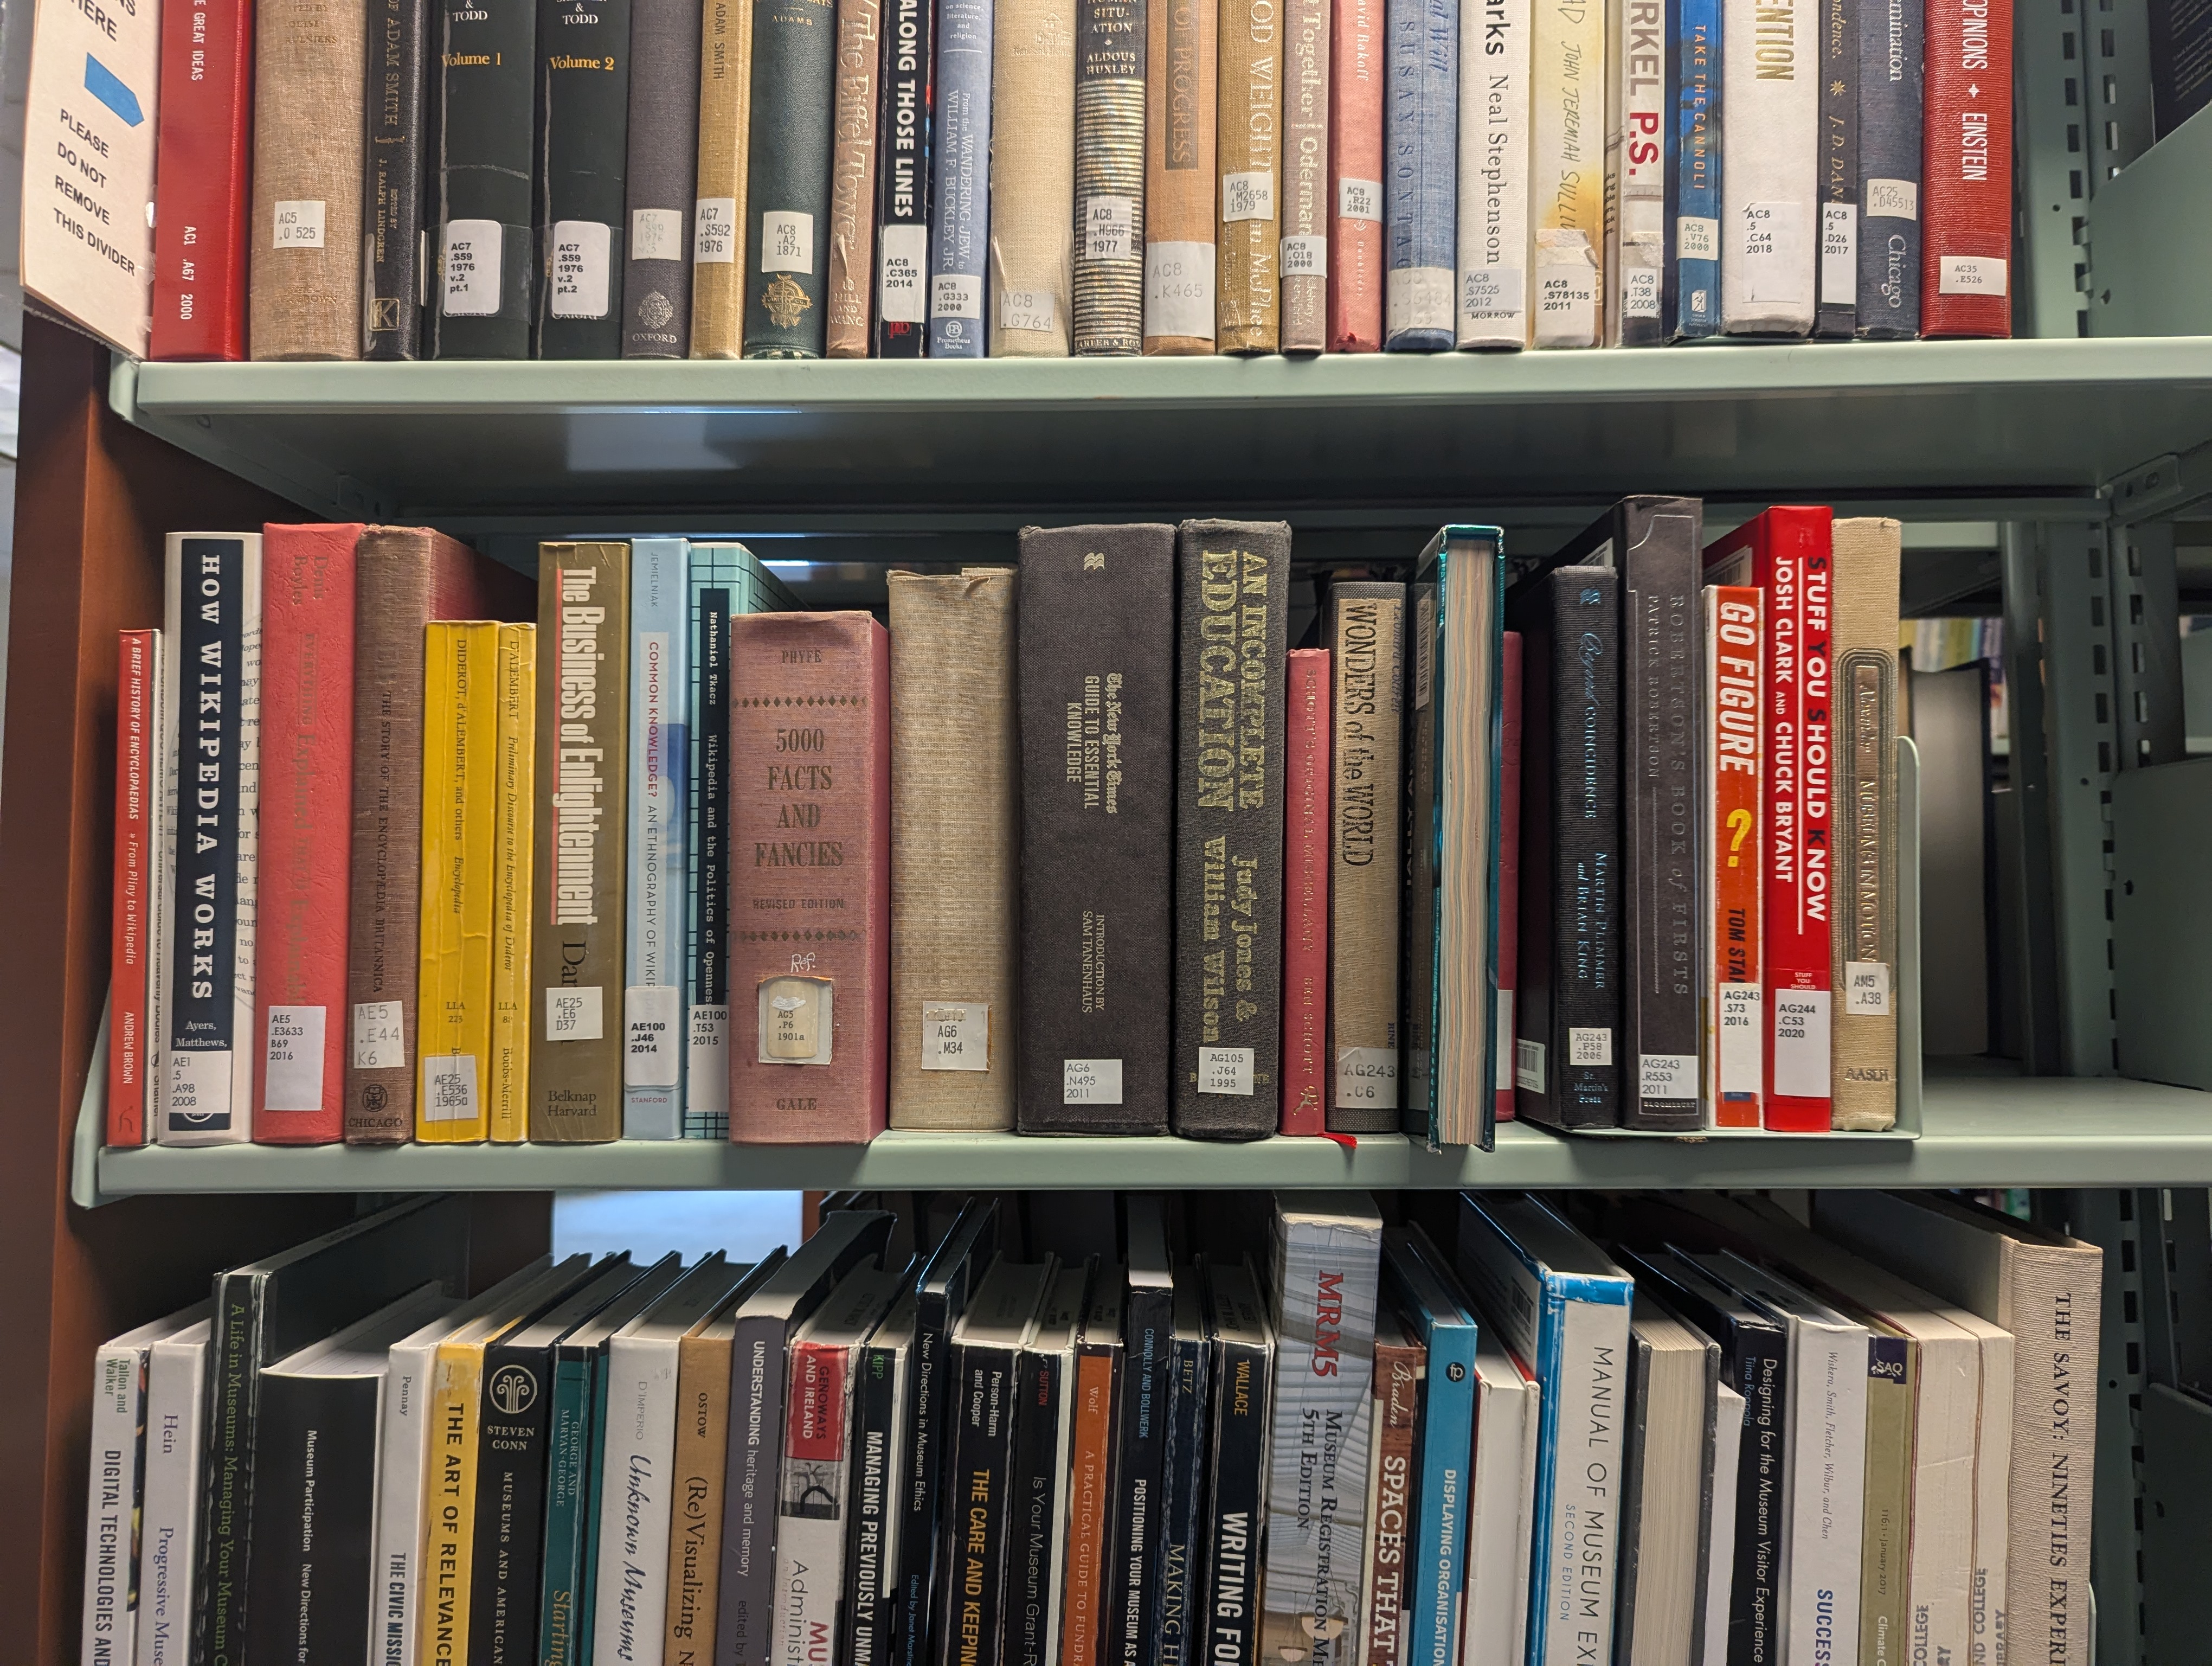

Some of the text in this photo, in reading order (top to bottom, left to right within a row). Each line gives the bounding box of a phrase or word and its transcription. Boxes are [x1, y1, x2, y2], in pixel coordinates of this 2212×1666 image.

[453, 10, 487, 22] TODD
[563, 14, 598, 24] TODD
[191, 12, 205, 81] GREAT IDEAS
[442, 53, 501, 66] Volume 1
[550, 56, 614, 69] Volume 2
[384, 18, 399, 126] ADAM SMITH
[895, 0, 918, 217] ALONG THOSE LINES
[1693, 25, 1706, 190] TAKE THE CANNOLI
[60, 109, 109, 158] PLEASE
[1629, 112, 1658, 176] P.S.
[1962, 112, 1987, 181] EINSTEIN
[58, 142, 107, 189] DO NOT
[1481, 75, 1509, 265] Neal Stephenson
[55, 175, 110, 226] REMOVE
[1746, 210, 1770, 219] AC8
[53, 208, 135, 276] THIS DIVIDER
[451, 242, 472, 251] AC7
[1746, 234, 1771, 242] .C64
[1746, 245, 1772, 254] 2018
[180, 226, 196, 320] AC1 .A67 2000
[450, 284, 468, 293] pt.1
[451, 263, 475, 271] 1976
[1545, 279, 1568, 289] AC8
[1881, 235, 1907, 308] Chicago
[1544, 291, 1589, 300] .S78135
[1544, 302, 1571, 310] 2011
[131, 648, 141, 675] BRIEF
[1198, 549, 1238, 811] EDUCATION
[1239, 552, 1268, 809] AN INCOMPLETE
[128, 677, 141, 720] HISTORY
[706, 612, 718, 799] Nathaniel Tkacz Wikipedia
[1719, 601, 1756, 776] GO FIGURE
[130, 723, 140, 736] OF
[647, 642, 659, 797] COMMON KNOWLEDGE?
[776, 729, 824, 752] 5000
[1066, 702, 1082, 782] KNOWLEDGE
[1084, 675, 1100, 809] GUIDE TO ESSENTIAL
[1774, 558, 1793, 882] JOSH CLARK AND CHUCK BRYANT
[1806, 557, 1827, 921] STUFF YOU SHOULD KNOW
[552, 566, 605, 925] The Business of Enlightenment
[127, 736, 140, 821] ENCYCLOPAEDIAS
[191, 555, 222, 998] HOW WIKIPEDIA WORKS
[768, 765, 832, 790] FACTS
[777, 804, 820, 828] AND
[754, 842, 843, 867] FANCIES
[1203, 836, 1226, 1043] William Wilson
[1231, 855, 1258, 1021] Judy Jones &
[1724, 991, 1760, 1001] AG243
[1724, 1003, 1745, 1013] .S73
[185, 1020, 216, 1031] Ayers,
[271, 1027, 303, 1036] .E3633
[272, 1015, 290, 1023] AE5
[631, 1023, 665, 1031] AE100
[631, 1033, 654, 1043] .J46
[1724, 1017, 1748, 1026] 2016
[123, 1013, 134, 1084] ANDREW BROWN
[176, 1037, 227, 1048] Matthews,
[271, 1040, 288, 1048] B69
[271, 1051, 293, 1060] 2016
[631, 1045, 657, 1053] 2014
[1210, 1054, 1243, 1063] AG105
[1066, 1063, 1090, 1072] AG6
[1066, 1077, 1095, 1086] .N495
[1210, 1078, 1236, 1088] 1995
[1212, 1066, 1236, 1075] .J64
[548, 1090, 596, 1104] Belknap
[548, 1105, 596, 1117] Harvard
[1066, 1089, 1090, 1099] 2011
[349, 1118, 403, 1127] CHICAGO
[1312, 1271, 1343, 1377] MRM5
[803, 1355, 818, 1439] AND IRELAND
[815, 1367, 828, 1440] GENOWAYS
[1234, 1361, 1250, 1416] WALLACE
[163, 1413, 178, 1454] Hein
[488, 1426, 535, 1436] STEVEN
[492, 1439, 527, 1450] CONN
[2049, 1293, 2072, 1567] THE SAVOY: NINETIES
[442, 1404, 464, 1534] THE ART OF
[737, 1341, 766, 1577] UNDERSTANDING heritage and memory
[301, 1429, 317, 1552] Museum Participation
[1577, 1347, 1614, 1618] MANUAL OF MUSEUM
[857, 1431, 883, 1622] MANAGING PREVIOUSLY
[966, 1469, 989, 1597] THE CARE AND
[1439, 1470, 1457, 1556] DISPLAYING
[1752, 1359, 1777, 1663] Designing for the Museum Visitor Experience
[95, 1450, 121, 1632] DIGITAL TECHNOLOGIES
[1373, 1456, 1406, 1654] SPACES THAT
[1217, 1513, 1249, 1619] WRITING
